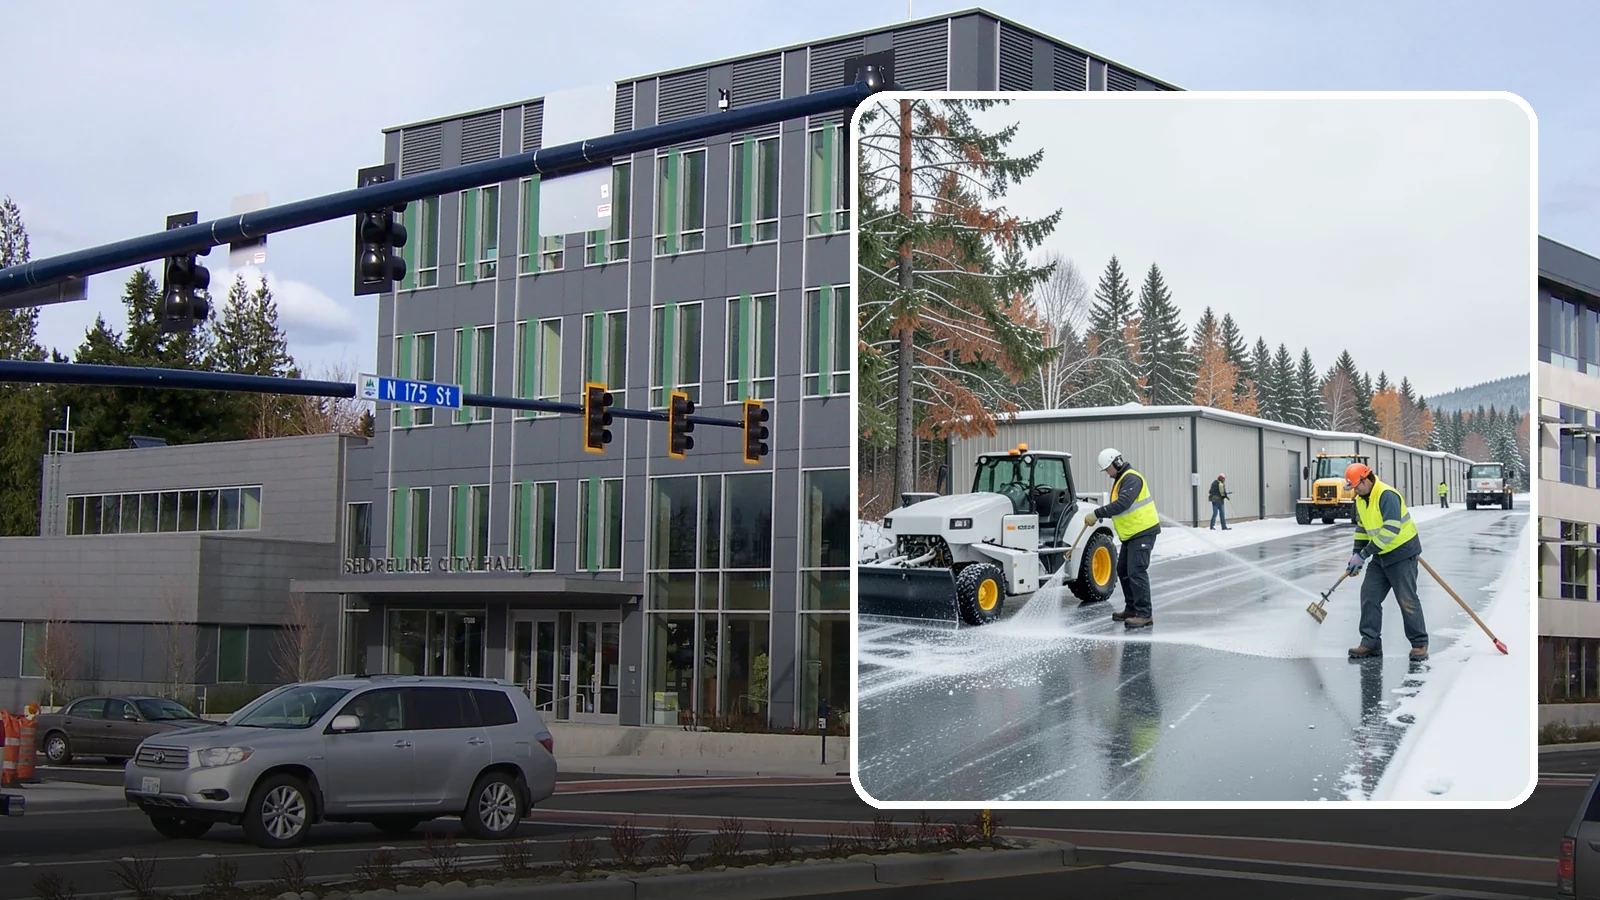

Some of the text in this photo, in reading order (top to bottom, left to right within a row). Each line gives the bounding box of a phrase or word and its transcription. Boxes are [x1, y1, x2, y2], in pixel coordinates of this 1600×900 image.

[387, 380, 451, 405] N 175 St
[344, 555, 525, 573] SHORELINE CITY HALL
